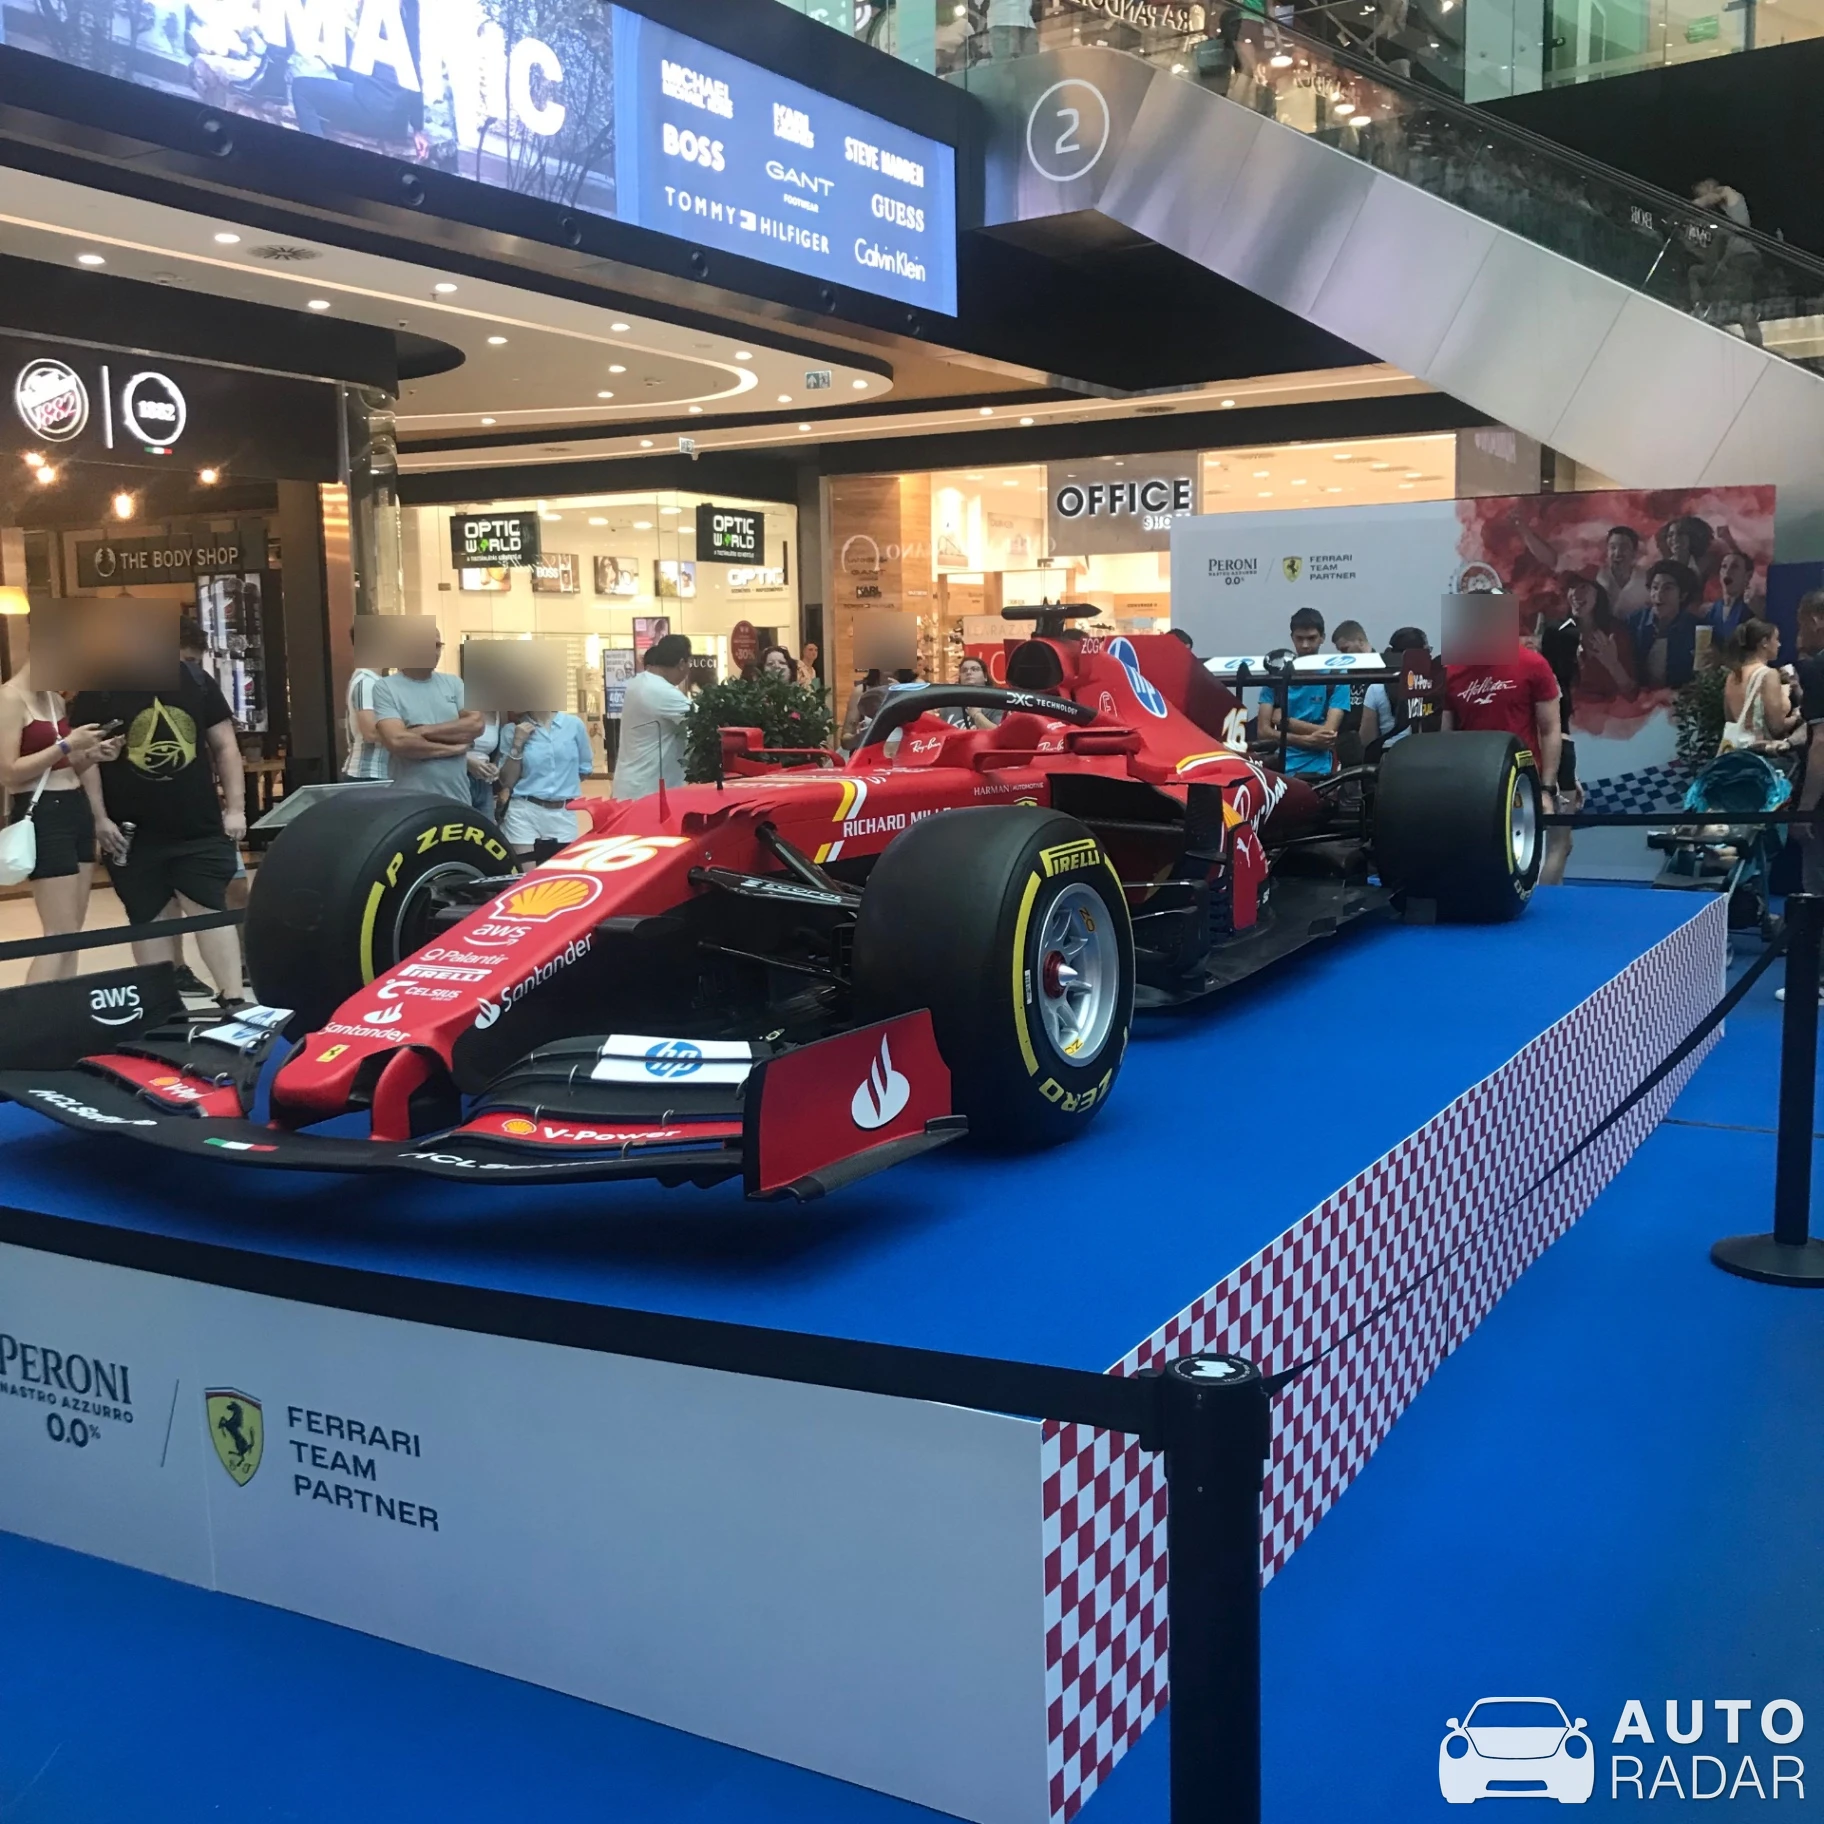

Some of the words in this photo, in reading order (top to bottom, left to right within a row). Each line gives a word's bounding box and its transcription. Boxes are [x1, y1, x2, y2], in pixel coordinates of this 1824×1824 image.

[663, 123, 725, 171] BOSS
[1055, 108, 1080, 154] 2
[766, 160, 835, 197] GANT
[845, 136, 879, 171] STEVE
[881, 149, 924, 188] MADDEN
[665, 186, 736, 225] TOMMY
[760, 217, 830, 254] HILFIGER
[872, 193, 925, 233] GUESS
[1056, 478, 1191, 518] OFFICE
[464, 519, 521, 538] OPTIC
[713, 515, 755, 535] OPTIC
[120, 552, 148, 569] THE
[152, 549, 192, 567] BODY
[196, 547, 239, 566] SHOP
[536, 567, 560, 578] BOSS
[1208, 558, 1258, 571] PERONI
[1309, 554, 1353, 563] FERRARI
[727, 567, 784, 586] OPTIC
[1309, 572, 1357, 581] PARTNER
[1006, 691, 1034, 707] DXC
[1036, 698, 1078, 715] TECHNOLOGY
[1457, 676, 1517, 702] Hollister
[910, 737, 942, 753] Ray-Ban
[1221, 707, 1249, 753] 16
[973, 784, 1010, 796] HARMAN
[1012, 781, 1044, 791] AUTOMOTIVE
[416, 823, 508, 861] ZERO
[843, 813, 906, 838] RICHARD
[386, 852, 404, 888] P
[535, 835, 692, 872] 16
[1040, 838, 1101, 878] PIRELLI
[472, 923, 532, 939] aws
[397, 963, 493, 983] PIRELLI
[442, 949, 508, 966] Palantir
[500, 932, 593, 1013] Santander
[90, 985, 141, 1010] aws
[405, 986, 463, 998] CELSIUS
[318, 1021, 413, 1043] Santander
[645, 1040, 702, 1078] hp
[1038, 1067, 1113, 1114] ZERO
[543, 1126, 682, 1142] V-Power
[0, 1333, 133, 1405] PERONI
[0, 1381, 57, 1407] NASTRO
[61, 1396, 134, 1423] AZZURRO
[46, 1412, 101, 1448] 0.0%
[287, 1405, 422, 1457] FERRARI
[290, 1439, 377, 1482] TEAM
[294, 1473, 440, 1532] PARTNER
